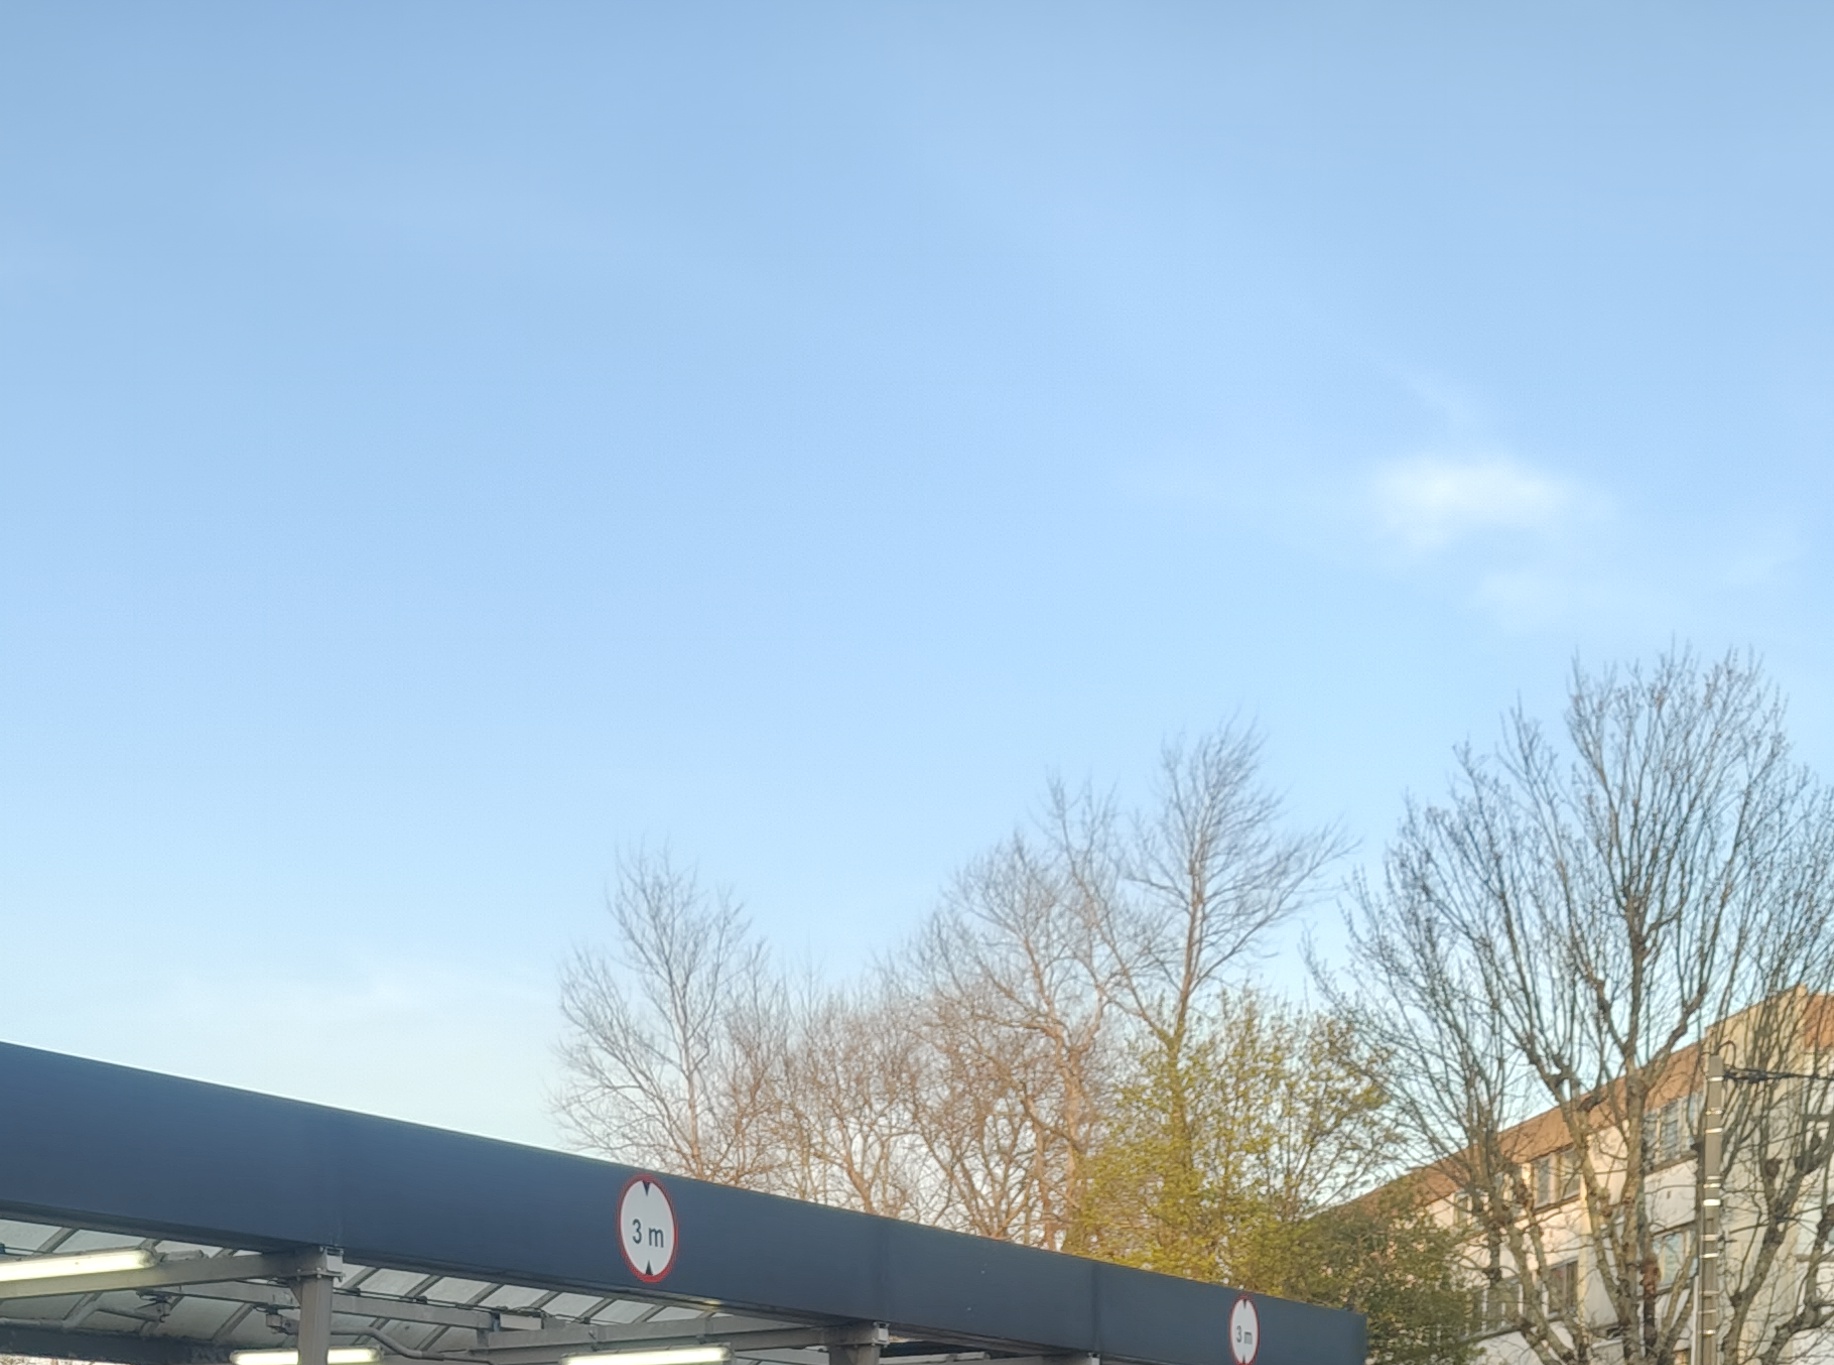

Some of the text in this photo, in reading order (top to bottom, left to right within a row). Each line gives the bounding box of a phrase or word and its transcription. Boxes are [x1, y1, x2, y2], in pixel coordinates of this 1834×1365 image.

[632, 1218, 665, 1249] 3 m
[1236, 1325, 1254, 1345] 3 m
